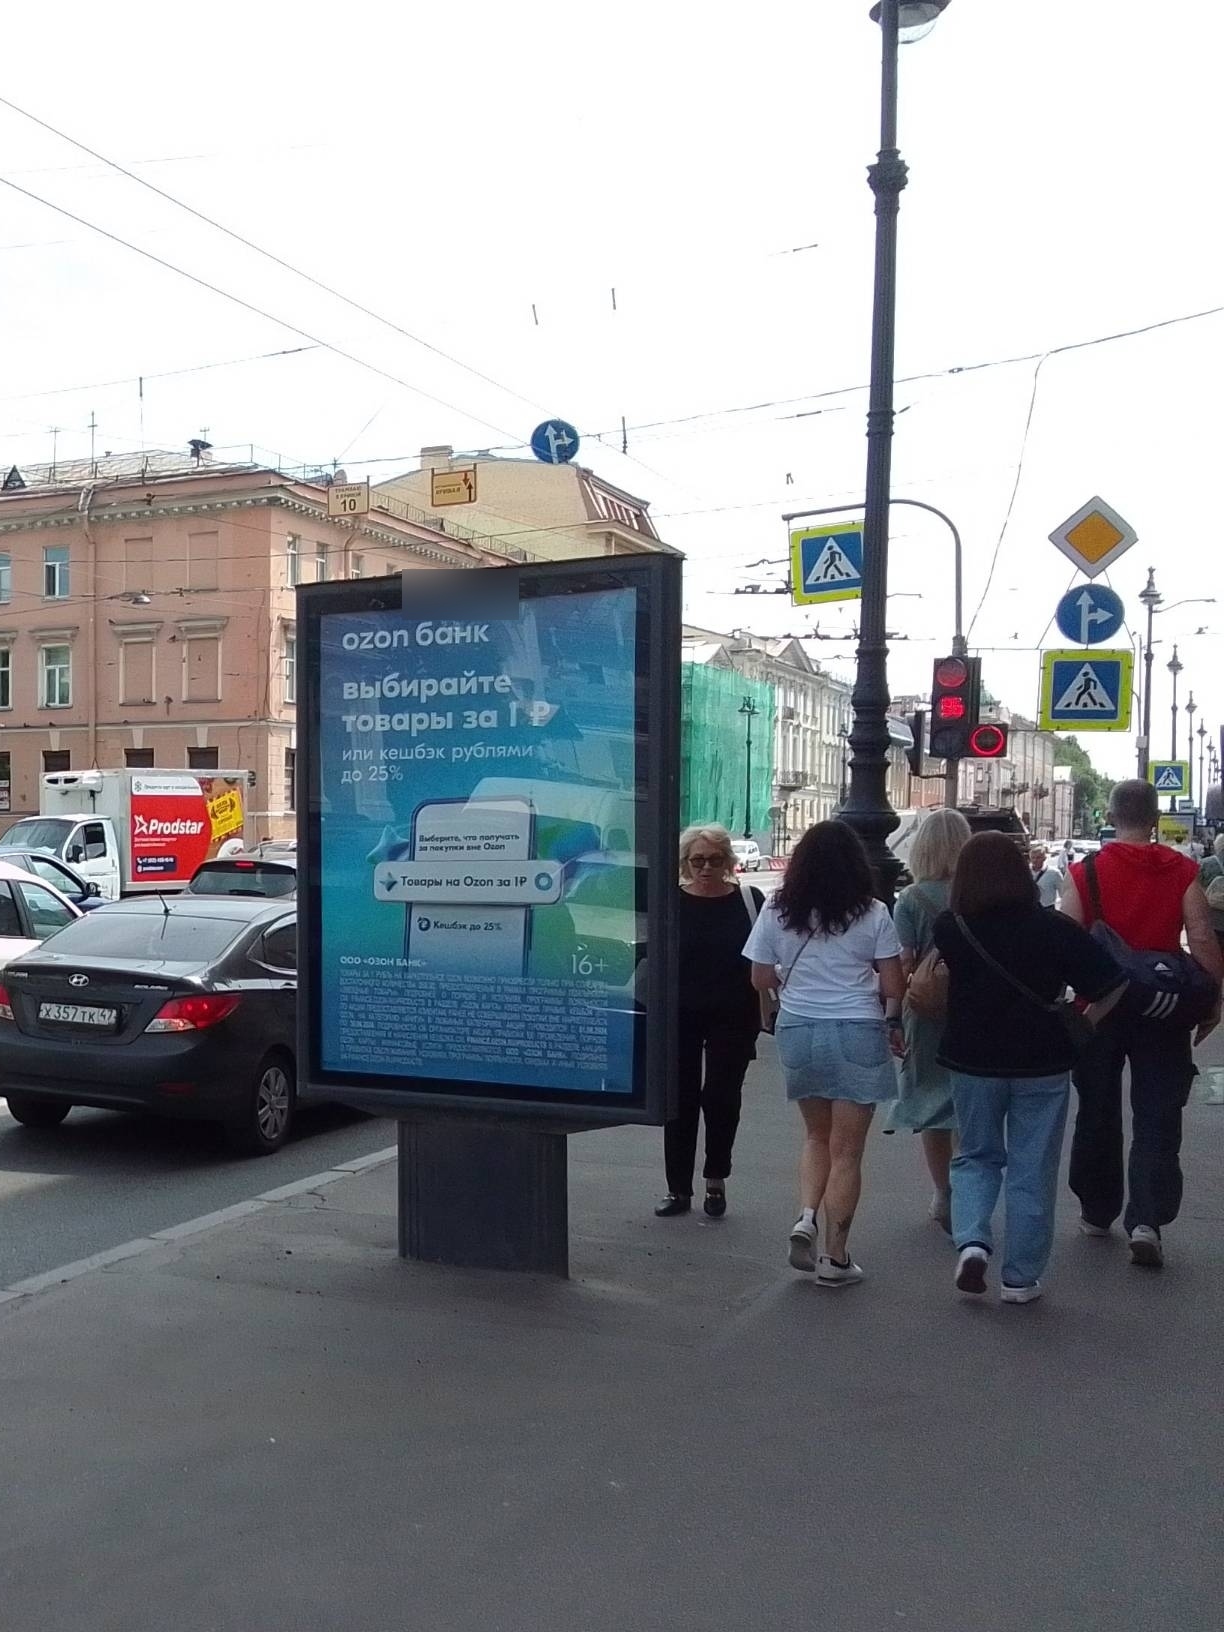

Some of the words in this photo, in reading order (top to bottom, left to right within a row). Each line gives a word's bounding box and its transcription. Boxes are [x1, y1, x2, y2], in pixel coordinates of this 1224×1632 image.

[341, 499, 356, 512] 10
[342, 629, 409, 650] ozon
[415, 621, 489, 646] банк
[343, 670, 512, 703] выбирайте
[341, 710, 453, 736] товары
[463, 709, 498, 729] за
[509, 701, 517, 727] 1
[342, 749, 373, 761] или
[380, 743, 445, 761] кешбэк
[452, 742, 534, 762] рублями
[341, 771, 362, 785] до
[368, 765, 404, 782] 25%
[149, 818, 204, 835] Prodstar
[419, 834, 461, 843] Выберите,
[479, 834, 520, 843] получать
[483, 843, 506, 851] Ozon
[400, 876, 443, 889] Товары
[445, 879, 460, 887] на
[464, 876, 494, 888] Ozon
[497, 879, 511, 887] за
[433, 921, 467, 931] Кешбэк
[469, 922, 481, 931] до
[483, 922, 503, 931] 25%
[340, 956, 361, 965] ООО
[572, 954, 609, 976] 16+
[99, 1010, 113, 1021] 47
